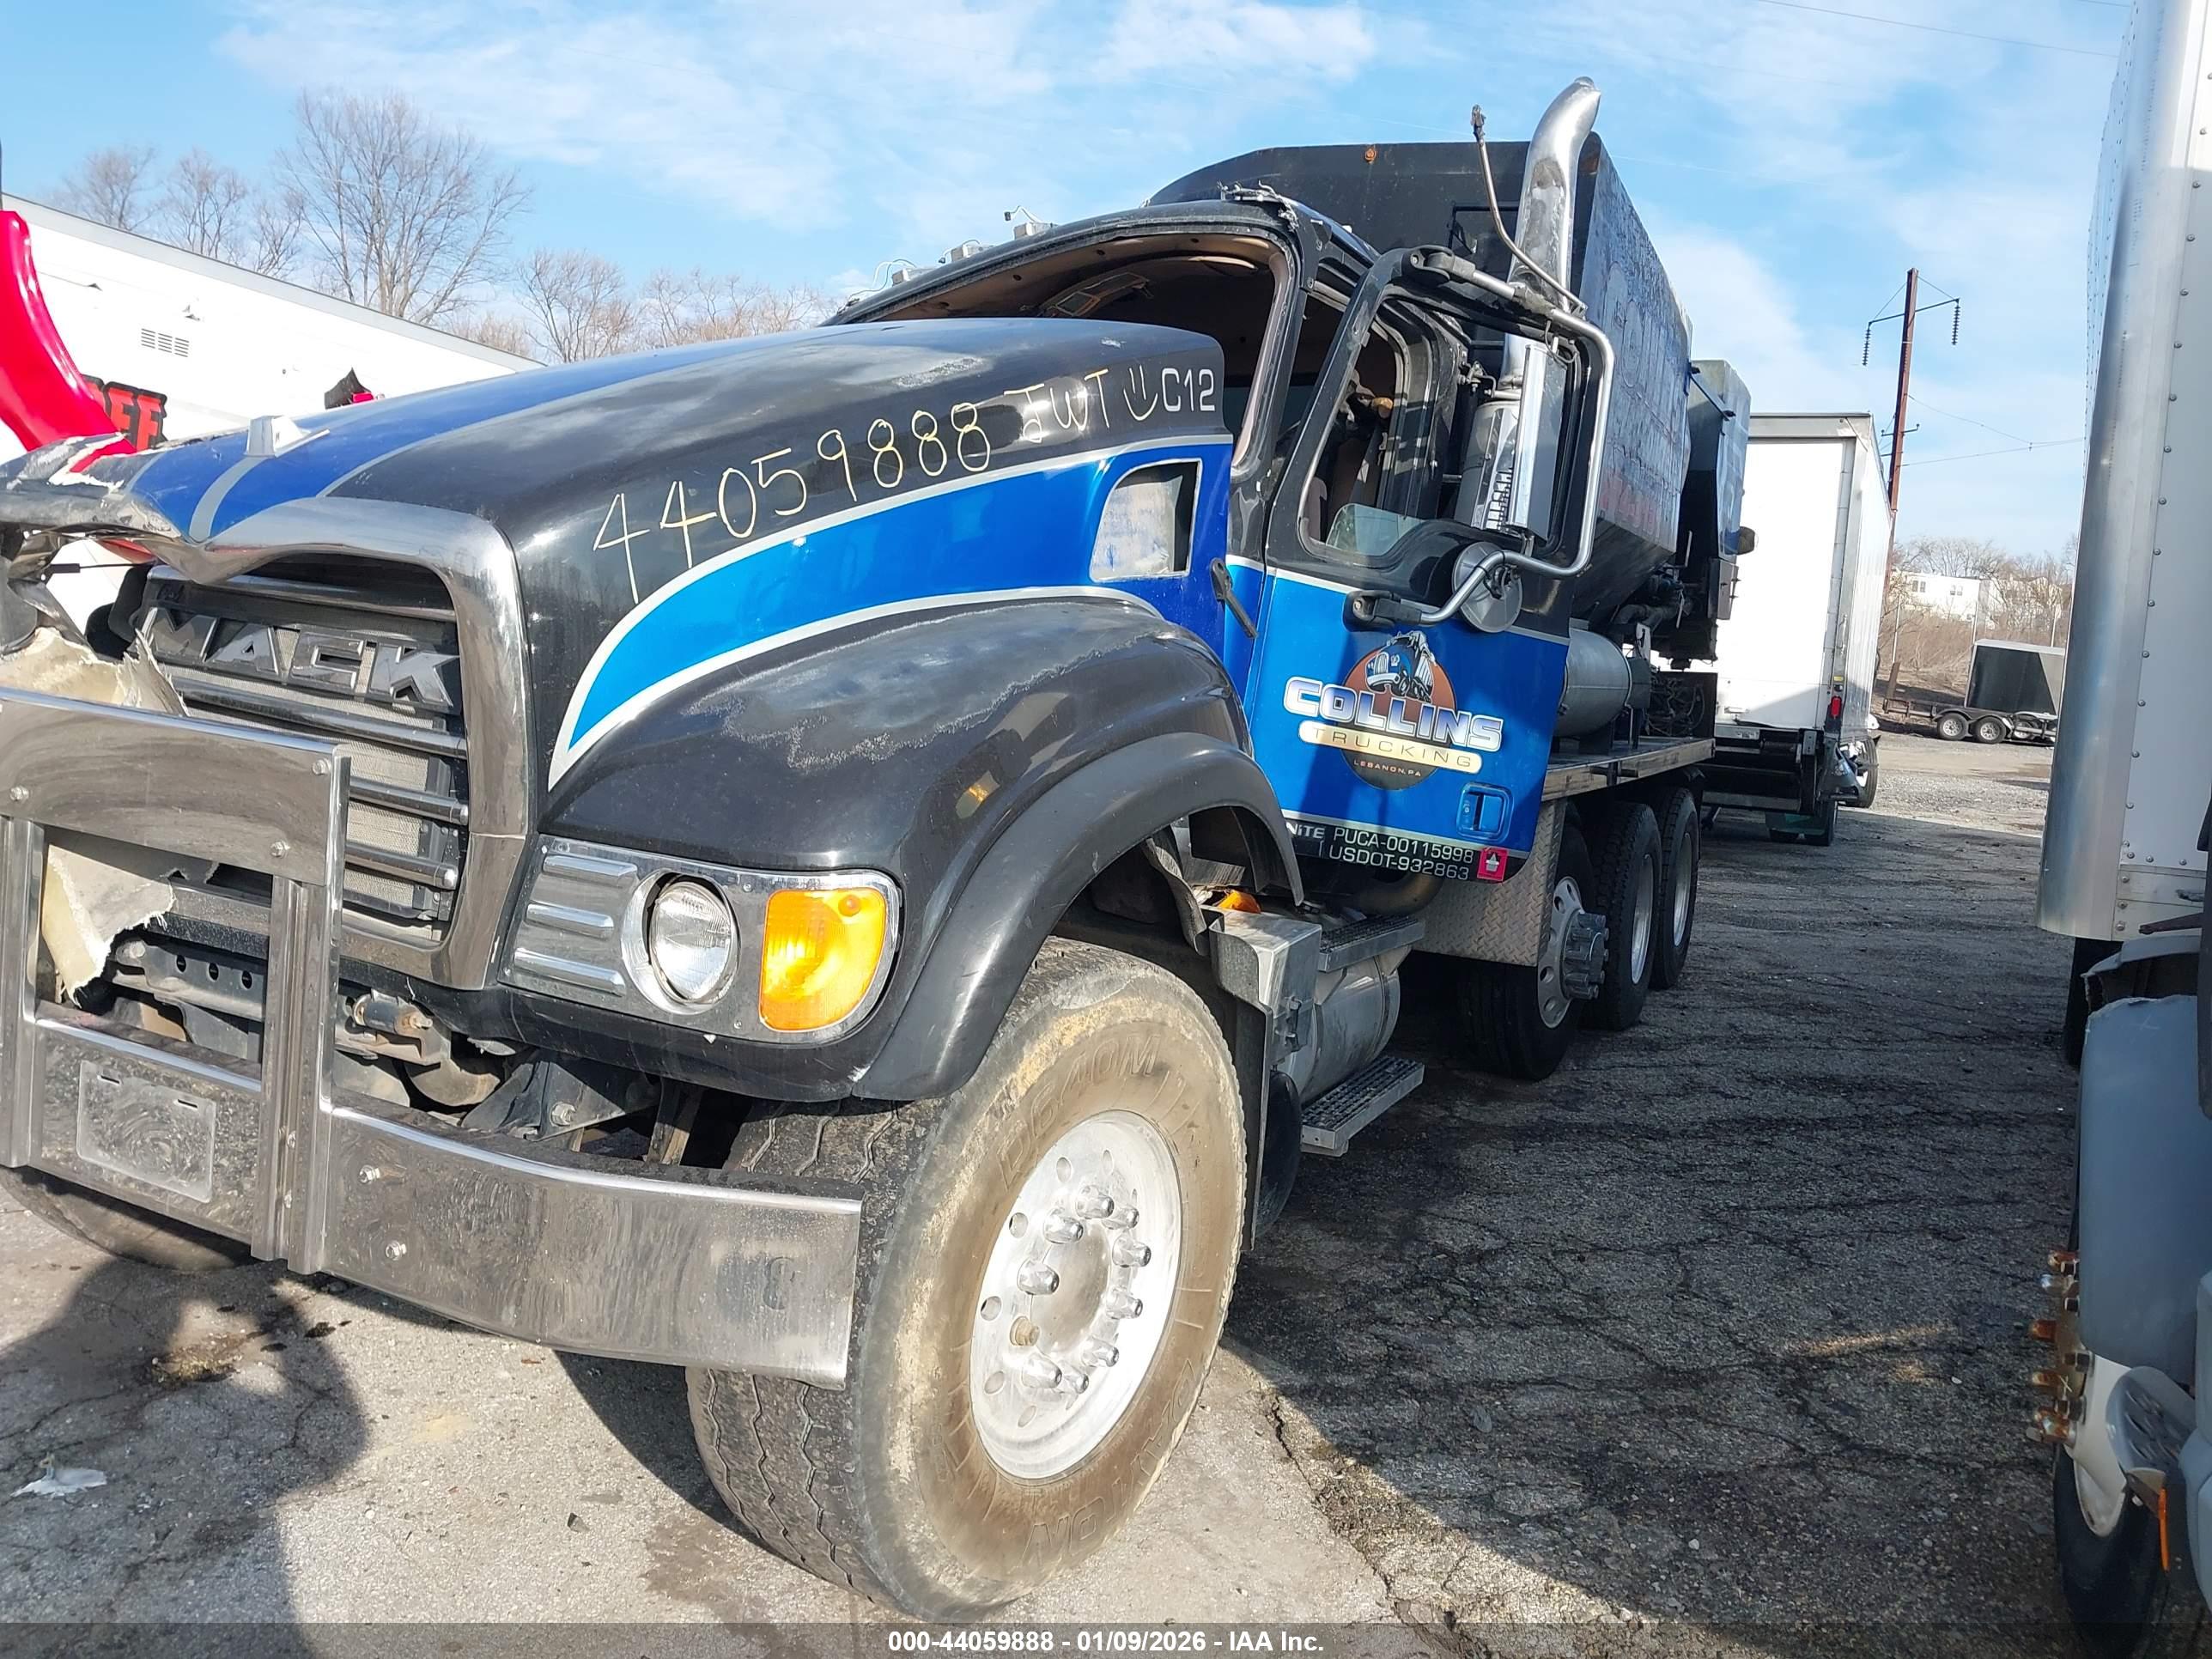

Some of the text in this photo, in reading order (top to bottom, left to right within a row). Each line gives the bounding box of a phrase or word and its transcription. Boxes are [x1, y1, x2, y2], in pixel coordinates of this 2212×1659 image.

[1162, 368, 1216, 412] C12
[592, 402, 991, 605] 44059888
[136, 606, 460, 708] MACK
[1283, 676, 1504, 752] COLLINS
[1313, 727, 1472, 768] TRUCKING
[1328, 844, 1469, 880] USDOT-932863
[1333, 827, 1474, 864] PUCA-00115998
